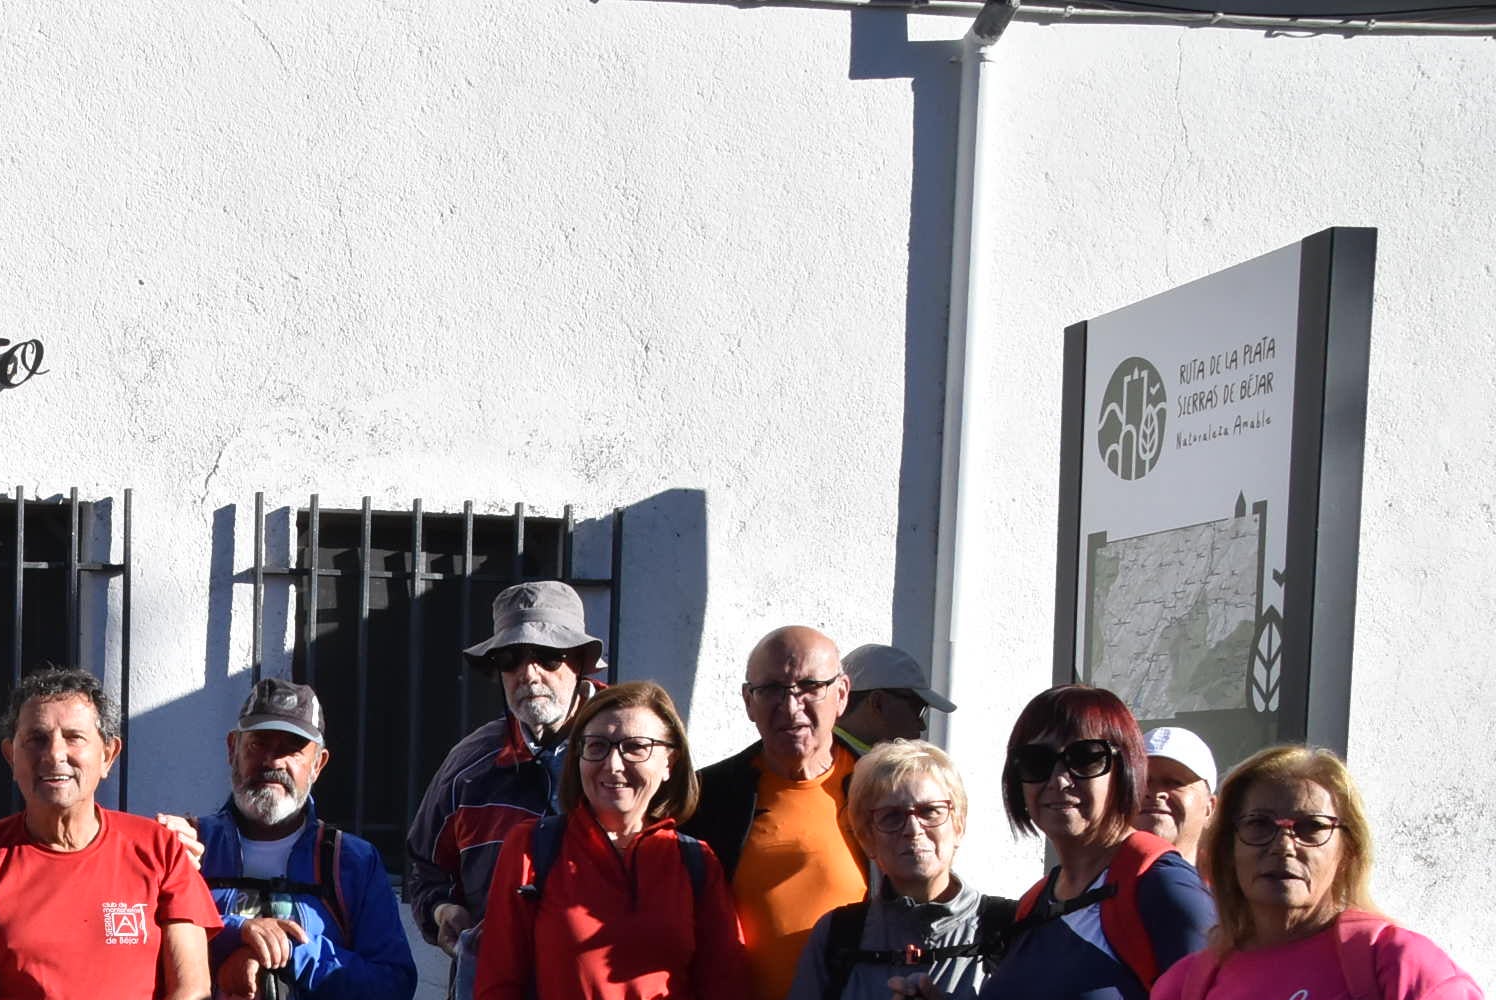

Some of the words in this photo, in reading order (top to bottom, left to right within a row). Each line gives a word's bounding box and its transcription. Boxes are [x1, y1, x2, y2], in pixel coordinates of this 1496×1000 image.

[1179, 358, 1205, 385] RUTA
[1209, 354, 1222, 376] DE
[1225, 349, 1238, 370] LA
[1243, 335, 1276, 366] PLATA
[1177, 384, 1218, 418] SIERRAS
[1223, 382, 1236, 405] DE
[1240, 371, 1274, 401] BÉJAR
[1176, 423, 1229, 450] Naturaleza
[1233, 408, 1272, 435] Amable
